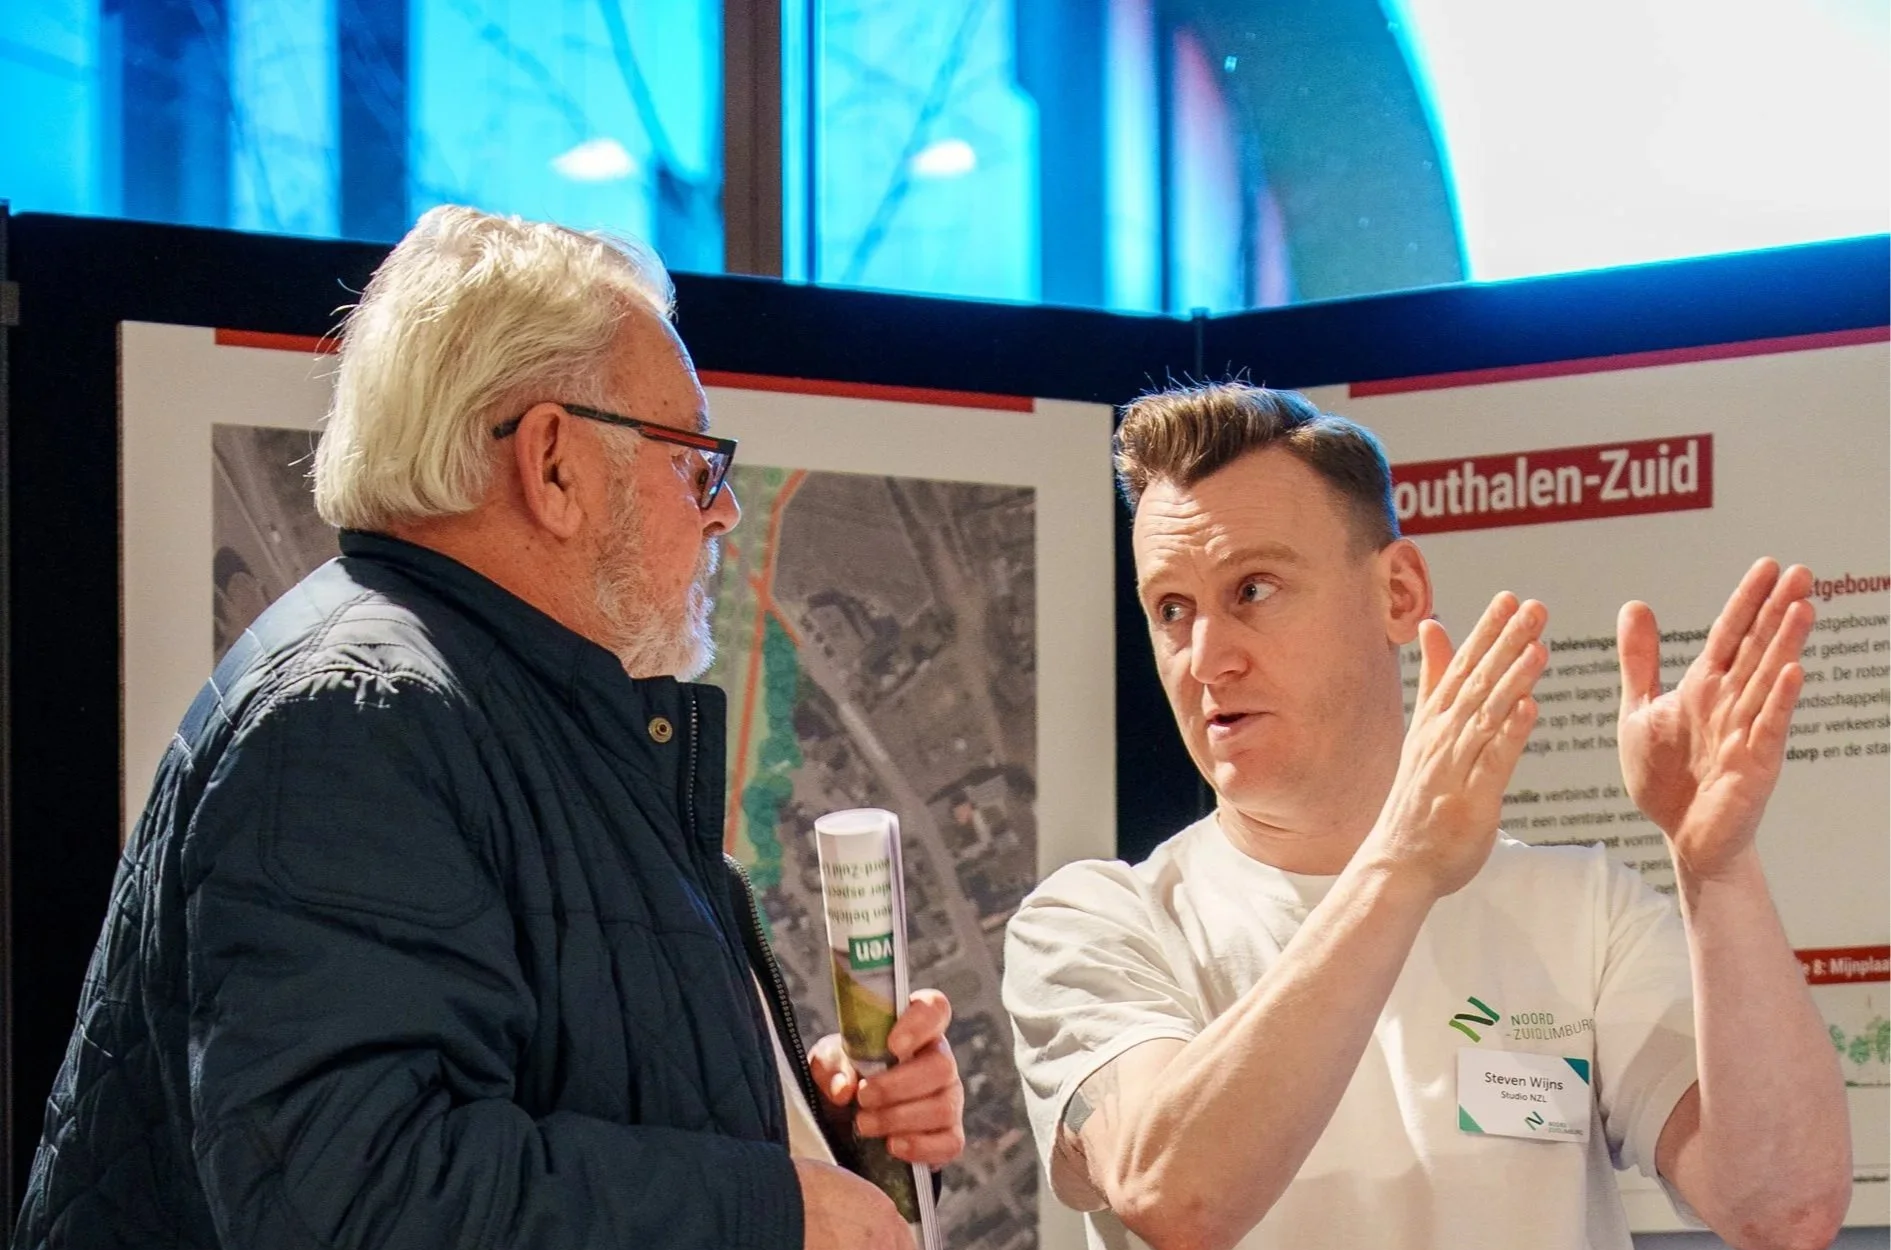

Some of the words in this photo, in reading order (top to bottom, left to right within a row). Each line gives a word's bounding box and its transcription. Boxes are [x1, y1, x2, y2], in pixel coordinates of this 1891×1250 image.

[1393, 439, 1699, 520] outhalen-Zuid
[1811, 573, 1889, 602] tgebouw
[1844, 743, 1862, 757] de
[1603, 783, 1620, 798] de
[1510, 1012, 1555, 1026] NOORD
[1484, 1071, 1526, 1086] Steven
[1529, 1075, 1564, 1092] Wijns
[1501, 1090, 1528, 1101] Studio
[1530, 1093, 1548, 1103] NZL
